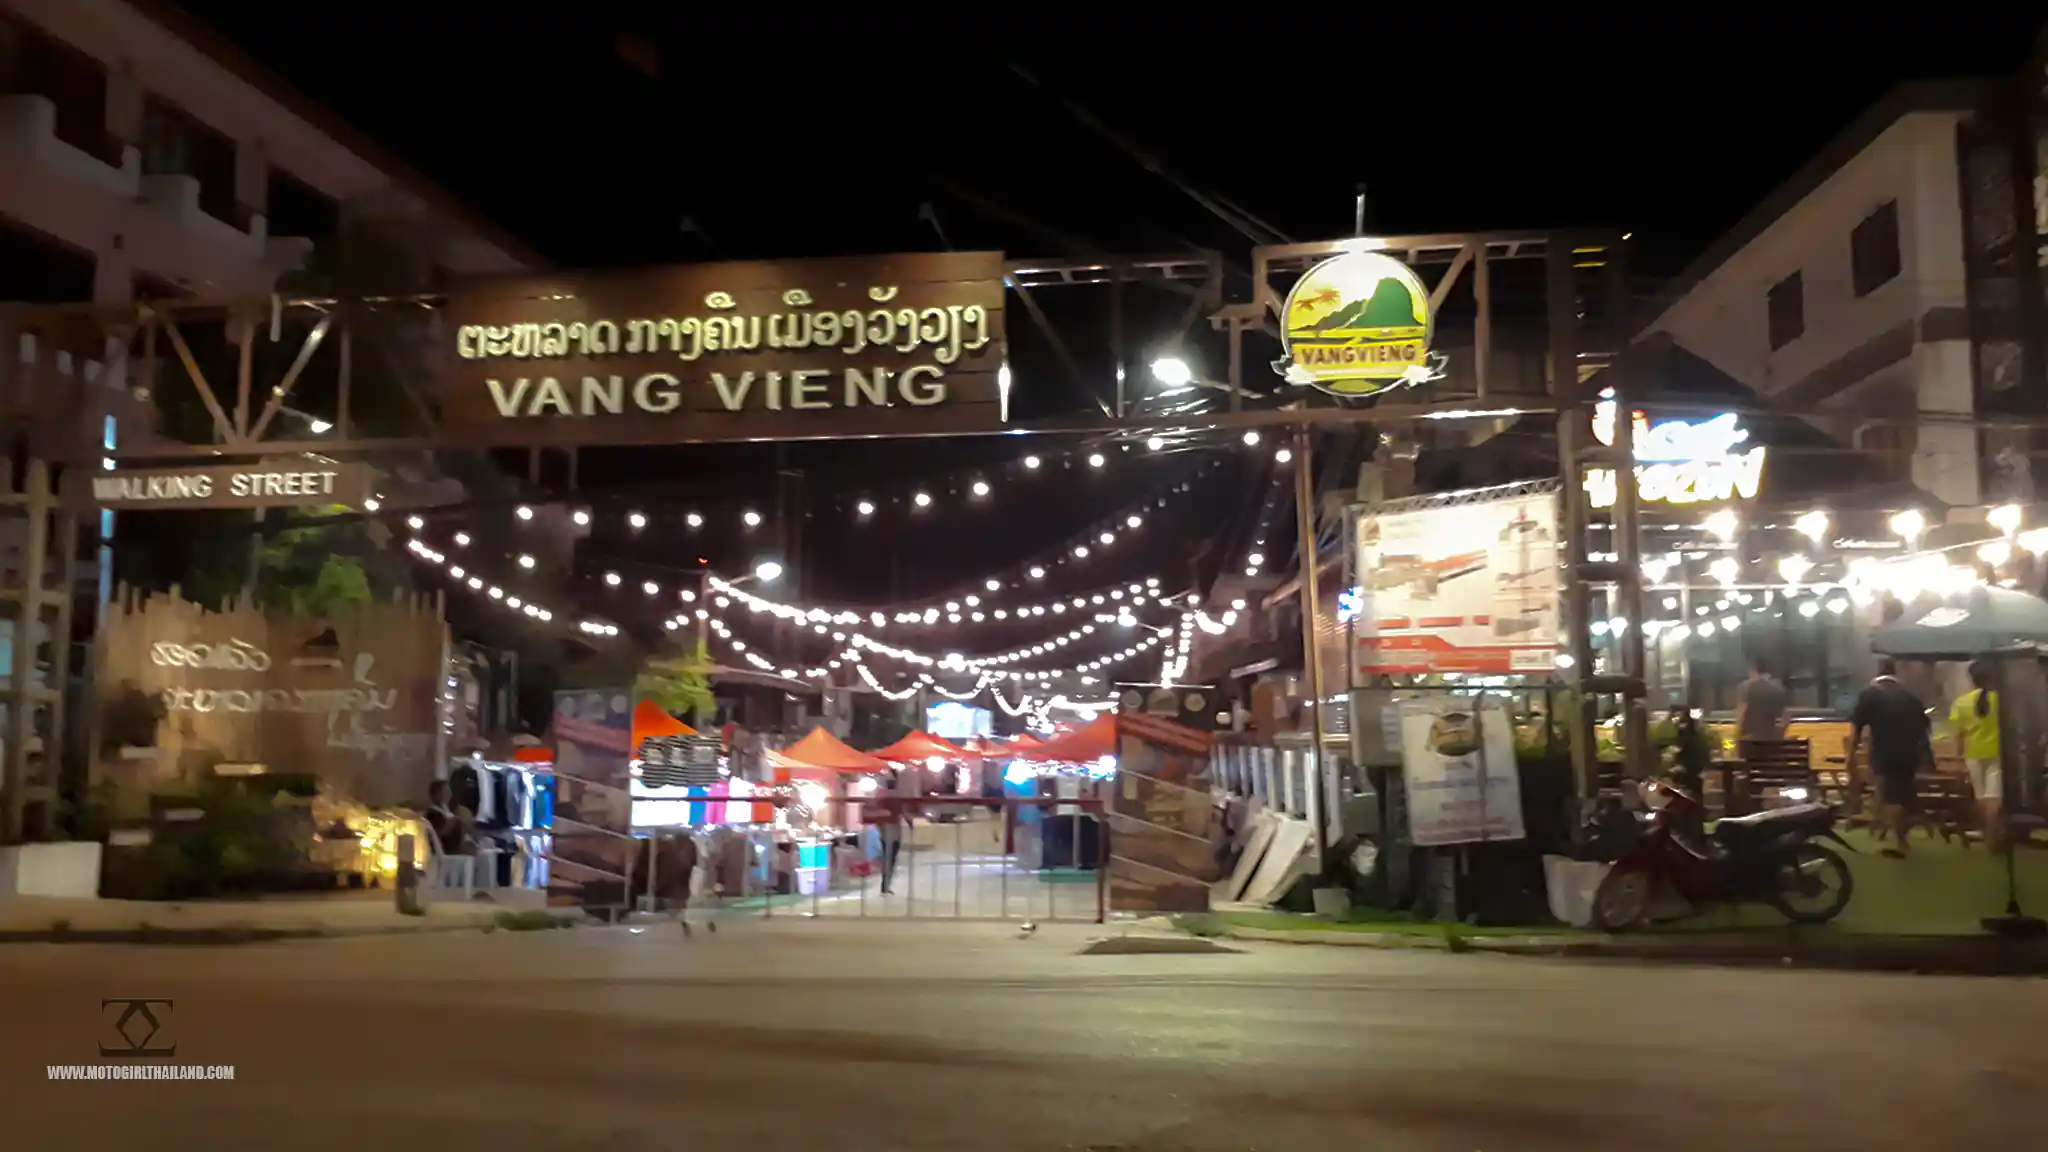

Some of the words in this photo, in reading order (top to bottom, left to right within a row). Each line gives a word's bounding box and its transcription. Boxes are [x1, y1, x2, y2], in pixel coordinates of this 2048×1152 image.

[486, 372, 682, 418] VANG
[711, 365, 947, 411] VIENG
[93, 475, 213, 501] WALKING
[230, 471, 338, 497] STREET
